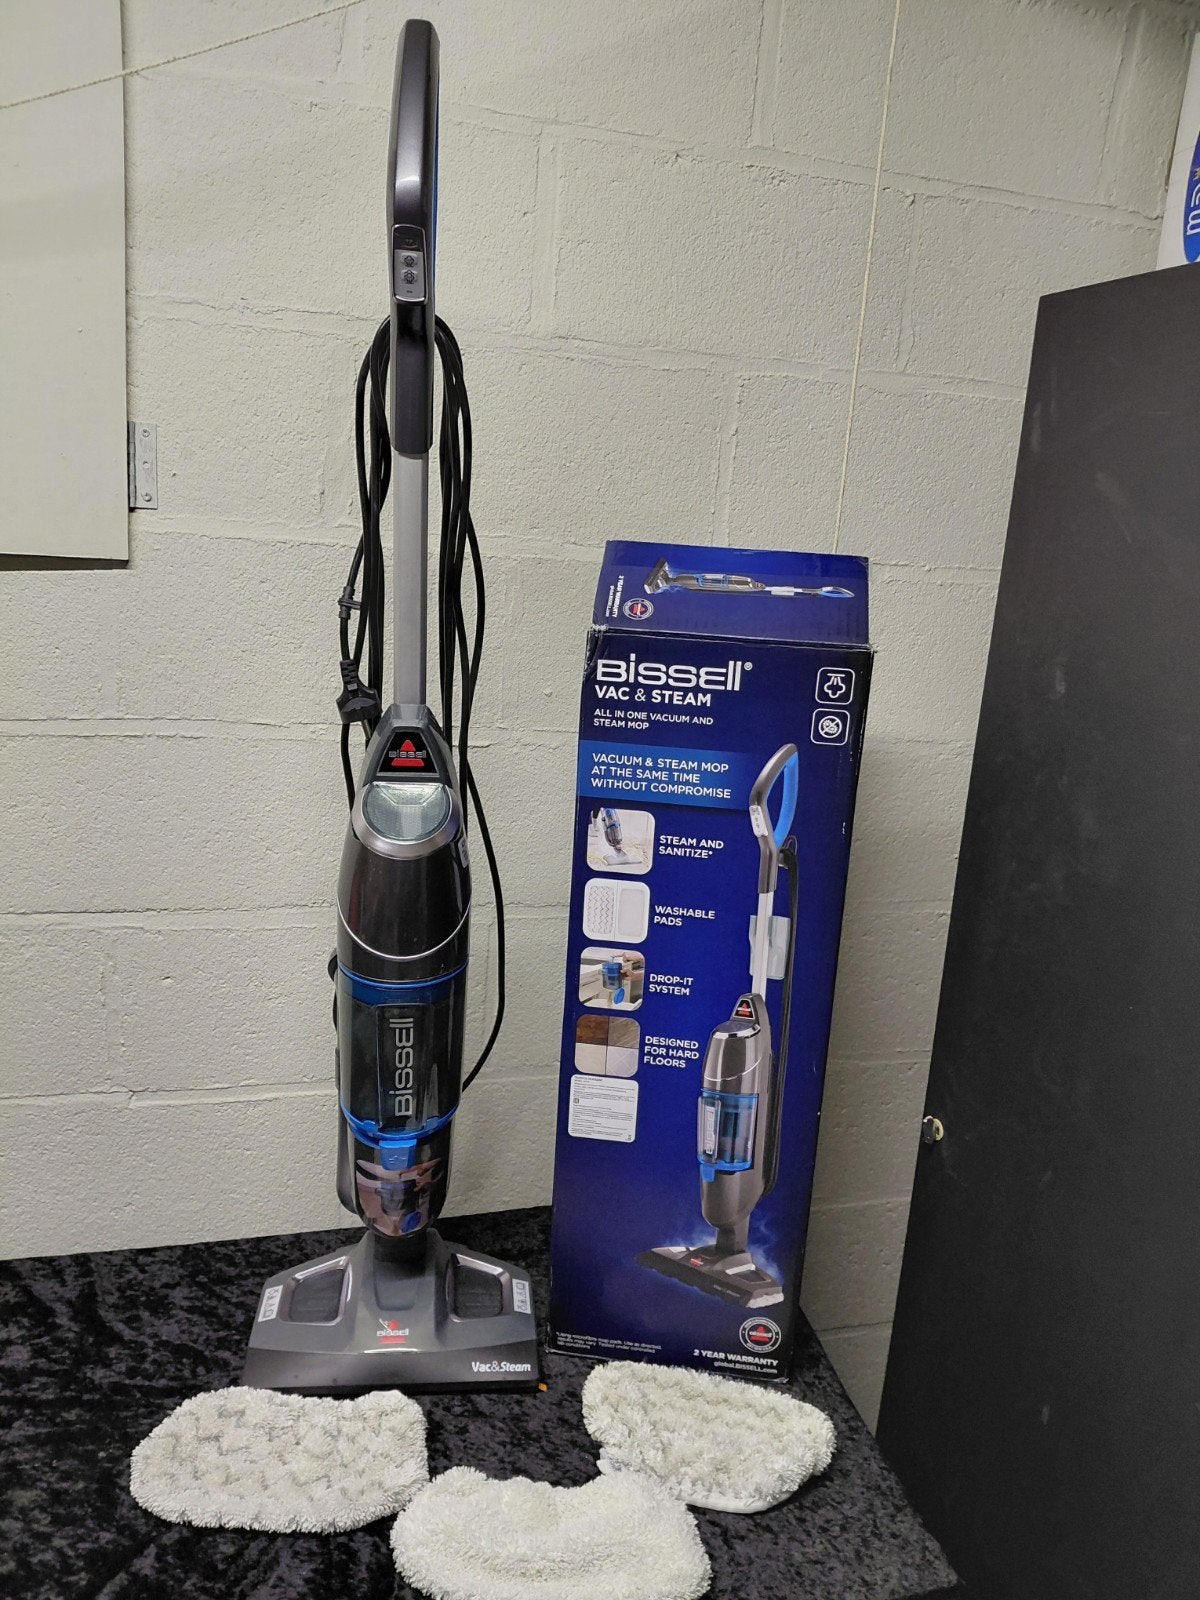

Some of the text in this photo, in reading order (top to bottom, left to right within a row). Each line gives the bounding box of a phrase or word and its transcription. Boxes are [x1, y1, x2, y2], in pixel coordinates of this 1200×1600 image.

[594, 685, 711, 707] VAC & STEAM
[594, 708, 713, 725] ALL IN ONE VACUUM AND
[593, 719, 649, 730] STEAM MOP
[592, 753, 729, 773] VACUUM & STEAM MOP
[591, 765, 700, 783] AT THE SAME TIME
[591, 778, 732, 798] WITHOUT COMPROMISE
[660, 835, 724, 849] STEAM AND
[654, 905, 716, 919] WASHABLE
[653, 916, 682, 926] PADS
[649, 973, 694, 986] DROP-IT
[649, 984, 690, 995] SYSTEM
[645, 1036, 699, 1049] DESIGNED
[644, 1046, 699, 1059] FOR HARD
[644, 1056, 686, 1068] FLOORS
[701, 1350, 725, 1359] YEAR
[727, 1353, 778, 1366] WARRANTY
